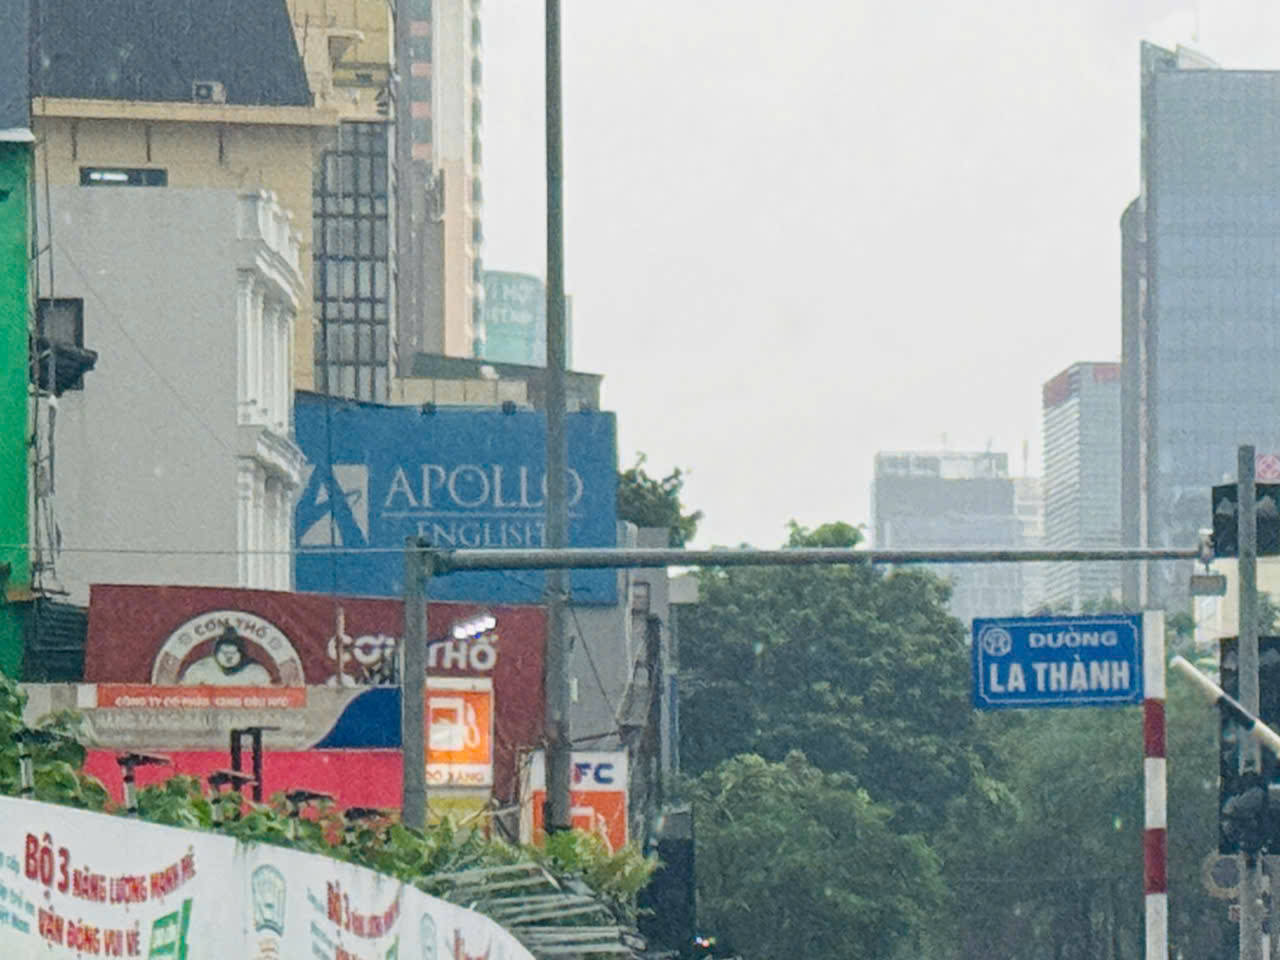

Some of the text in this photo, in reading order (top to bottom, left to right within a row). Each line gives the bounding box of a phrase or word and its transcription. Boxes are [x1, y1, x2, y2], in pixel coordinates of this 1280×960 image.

[384, 463, 584, 509] APOLLO
[1028, 626, 1118, 649] ĐƯỜNG
[989, 654, 1130, 693] LA THÀNH
[573, 763, 615, 785] FC
[25, 832, 54, 900] BỘ
[57, 847, 70, 894] 3
[72, 865, 107, 903] NĂNG
[38, 904, 64, 949] VẬN
[67, 917, 100, 960] ĐỘNG
